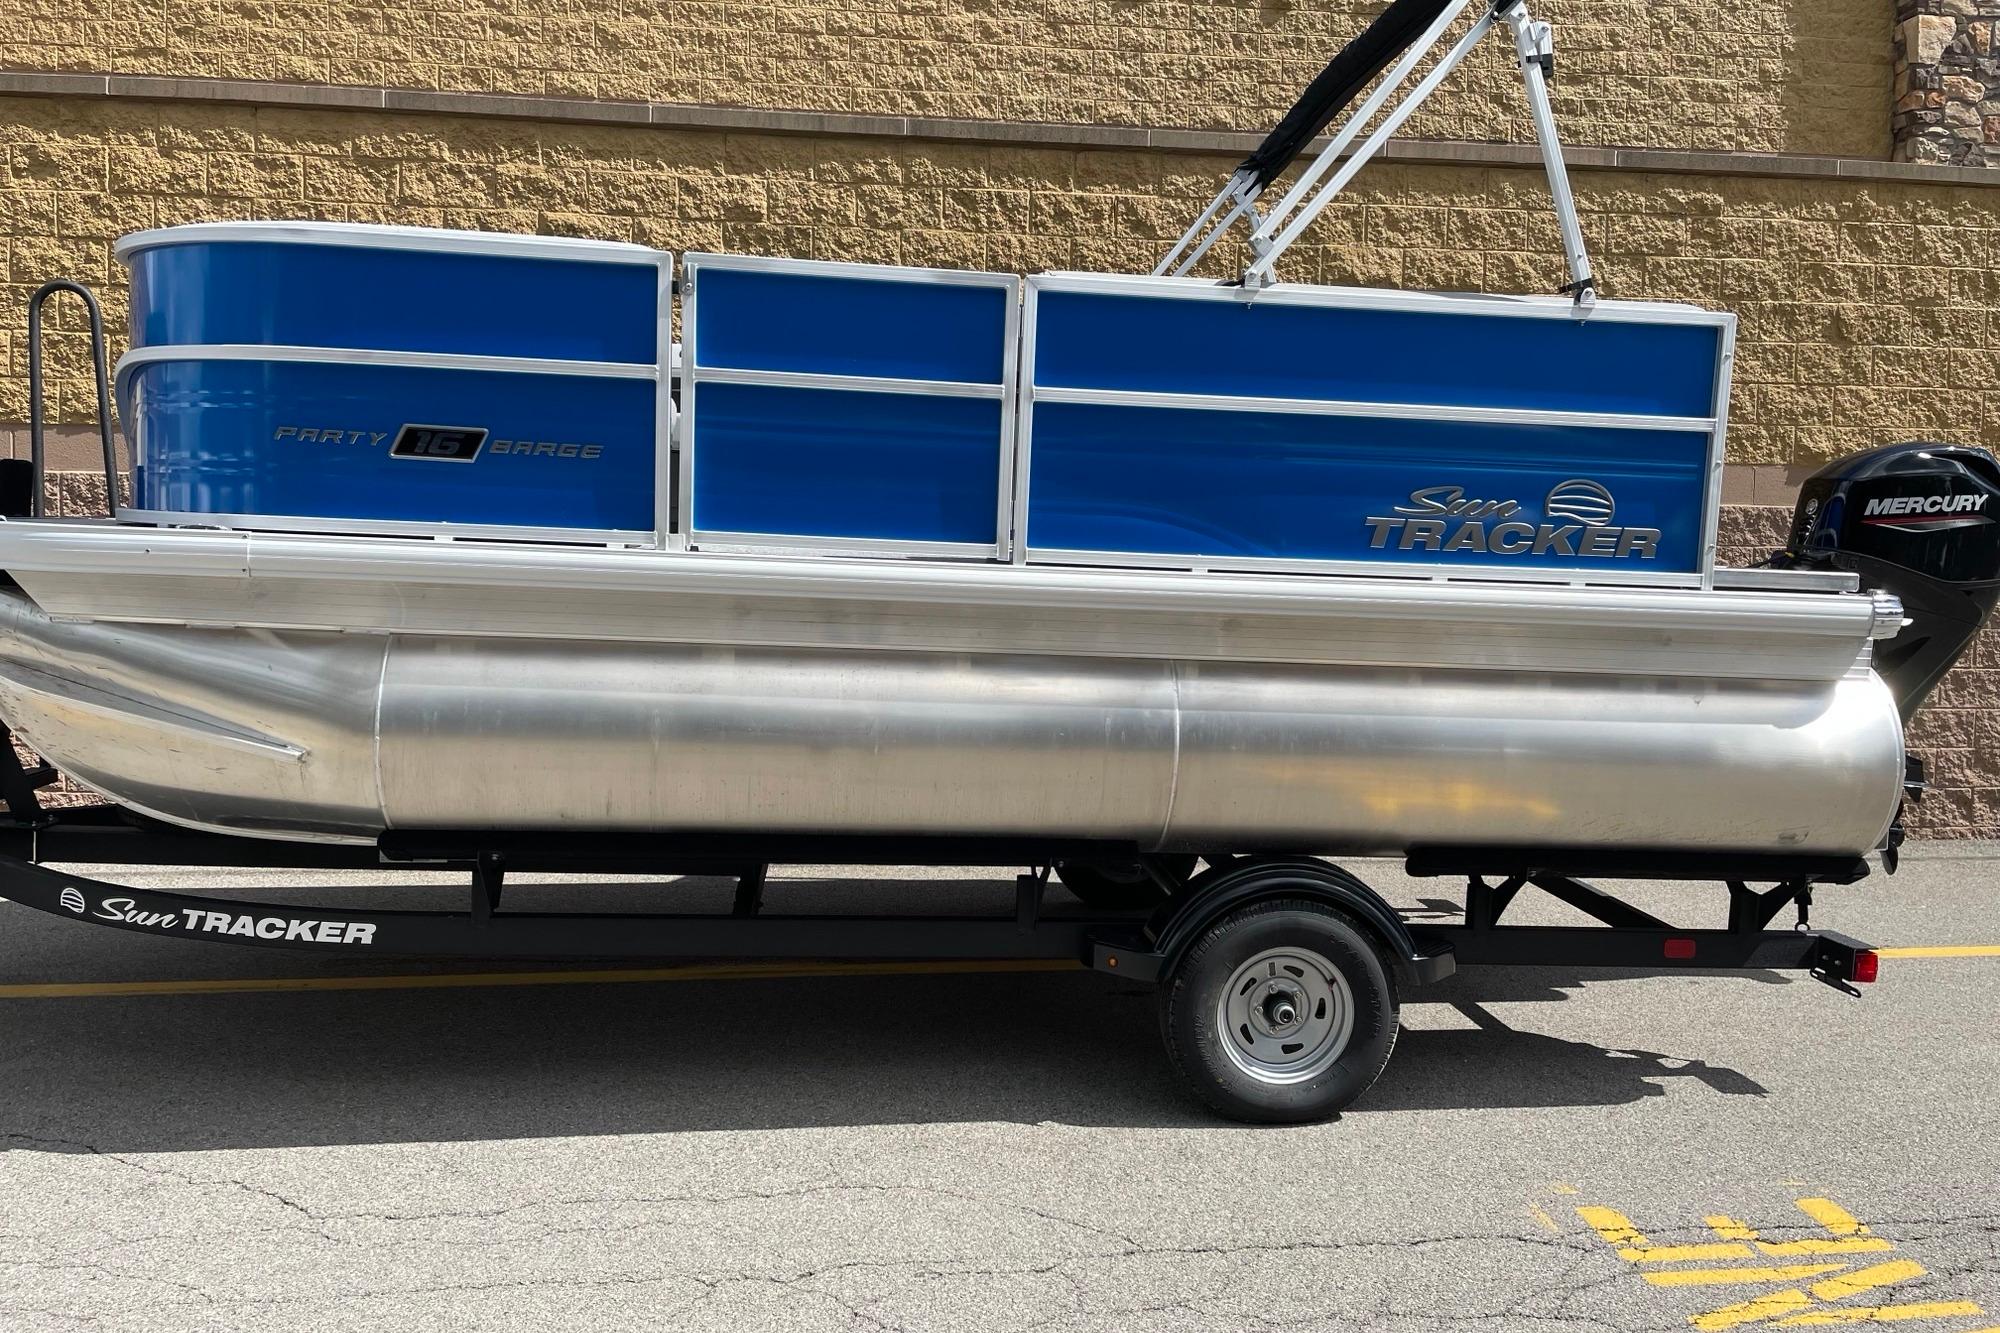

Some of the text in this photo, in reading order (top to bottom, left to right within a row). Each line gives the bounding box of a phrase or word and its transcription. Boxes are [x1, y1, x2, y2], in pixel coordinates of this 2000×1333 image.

[274, 426, 605, 460] PARTY 16 BARGE
[1393, 485, 1522, 519] Sun
[1863, 493, 1989, 516] MERCURY
[1365, 516, 1663, 560] TRACKER
[92, 897, 377, 945] Sun TRACKER
